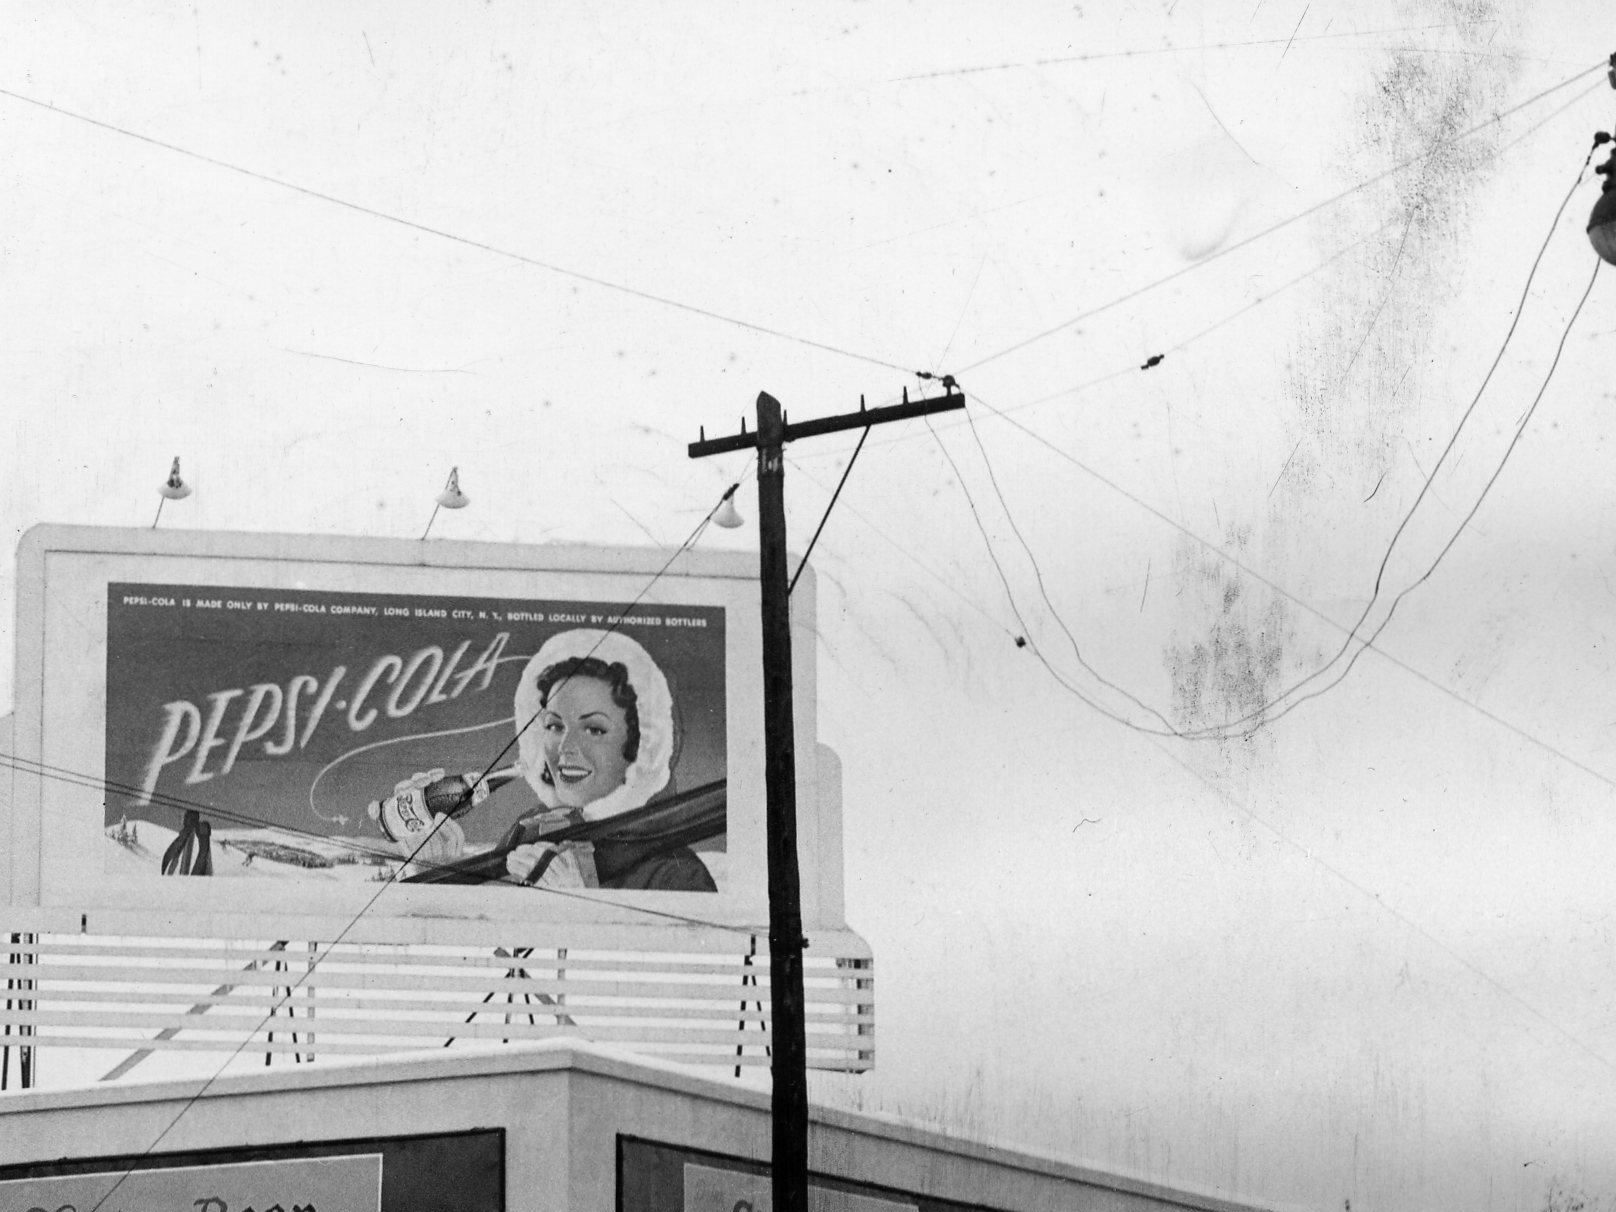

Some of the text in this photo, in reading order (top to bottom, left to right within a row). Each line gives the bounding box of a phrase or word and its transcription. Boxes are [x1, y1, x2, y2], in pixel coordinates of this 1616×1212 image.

[123, 596, 176, 607] PEPSI-COLA
[196, 599, 222, 608] MADE
[226, 600, 252, 610] ONLY
[257, 601, 268, 610] BY
[274, 602, 326, 614] PEPSI-COLA
[330, 605, 379, 617] COMPANY,
[384, 606, 410, 617] LONG
[415, 608, 447, 618] ISLAND
[452, 609, 474, 620] CITY,
[507, 612, 544, 622] BOTTLED
[548, 613, 585, 624] LOCALLY
[591, 614, 603, 624] BY
[607, 615, 662, 626] AUTHORIZED
[665, 617, 708, 628] BOTTLERS
